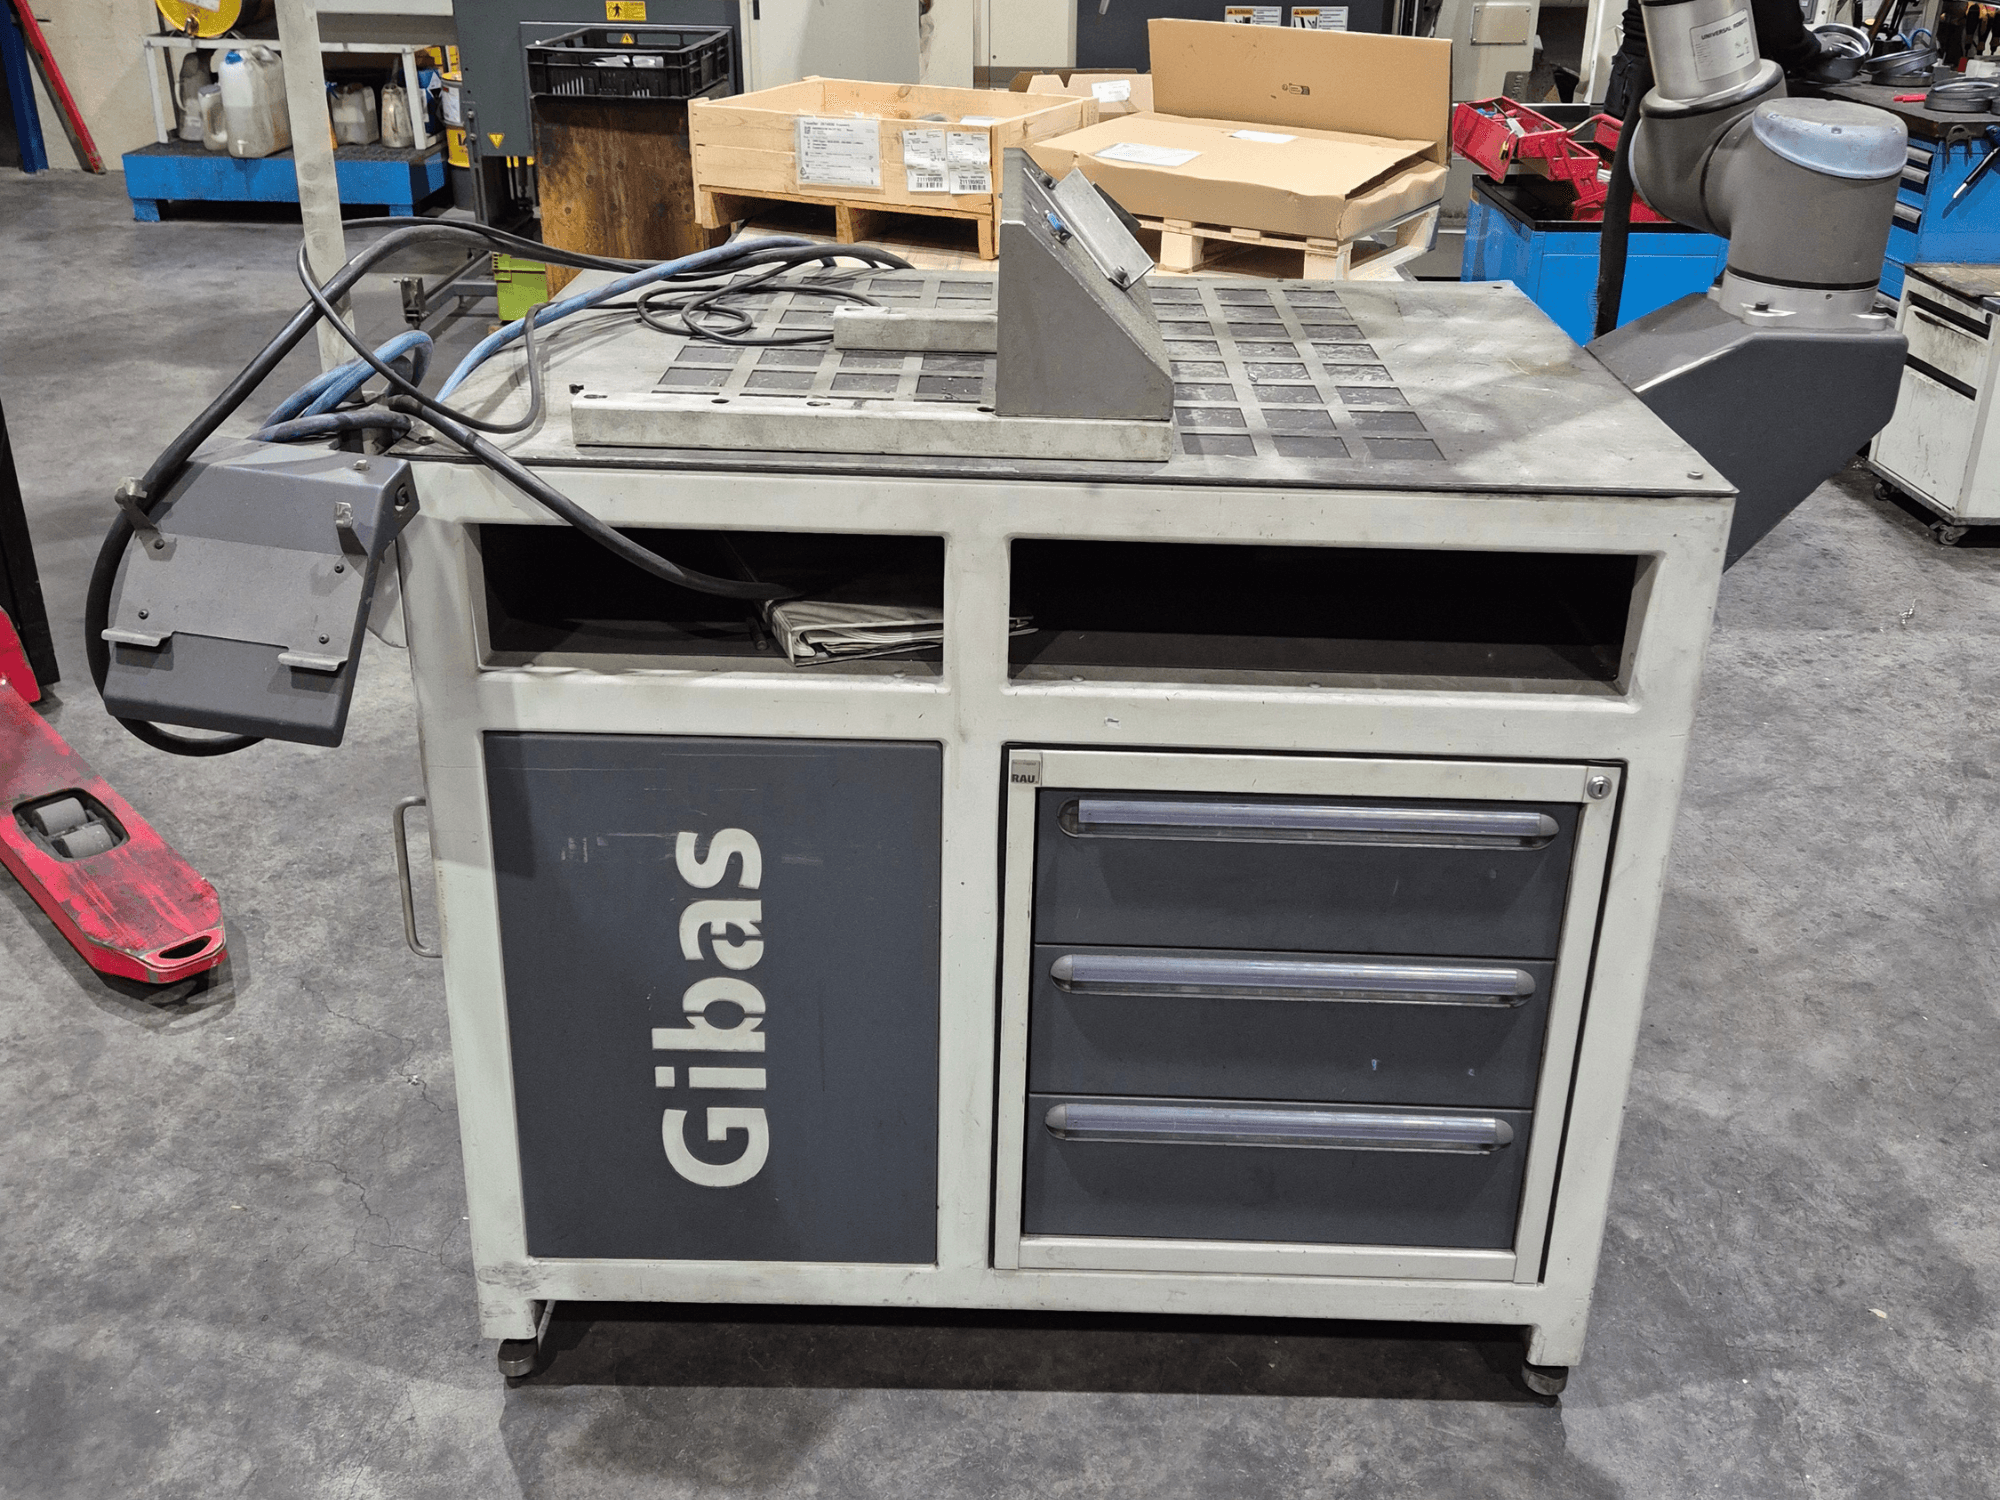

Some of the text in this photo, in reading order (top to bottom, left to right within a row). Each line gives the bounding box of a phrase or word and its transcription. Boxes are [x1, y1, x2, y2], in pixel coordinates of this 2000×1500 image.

[1701, 26, 1732, 40] UNIVERSAL
[1011, 774, 1036, 784] RAU
[652, 828, 769, 1187] Gibas
